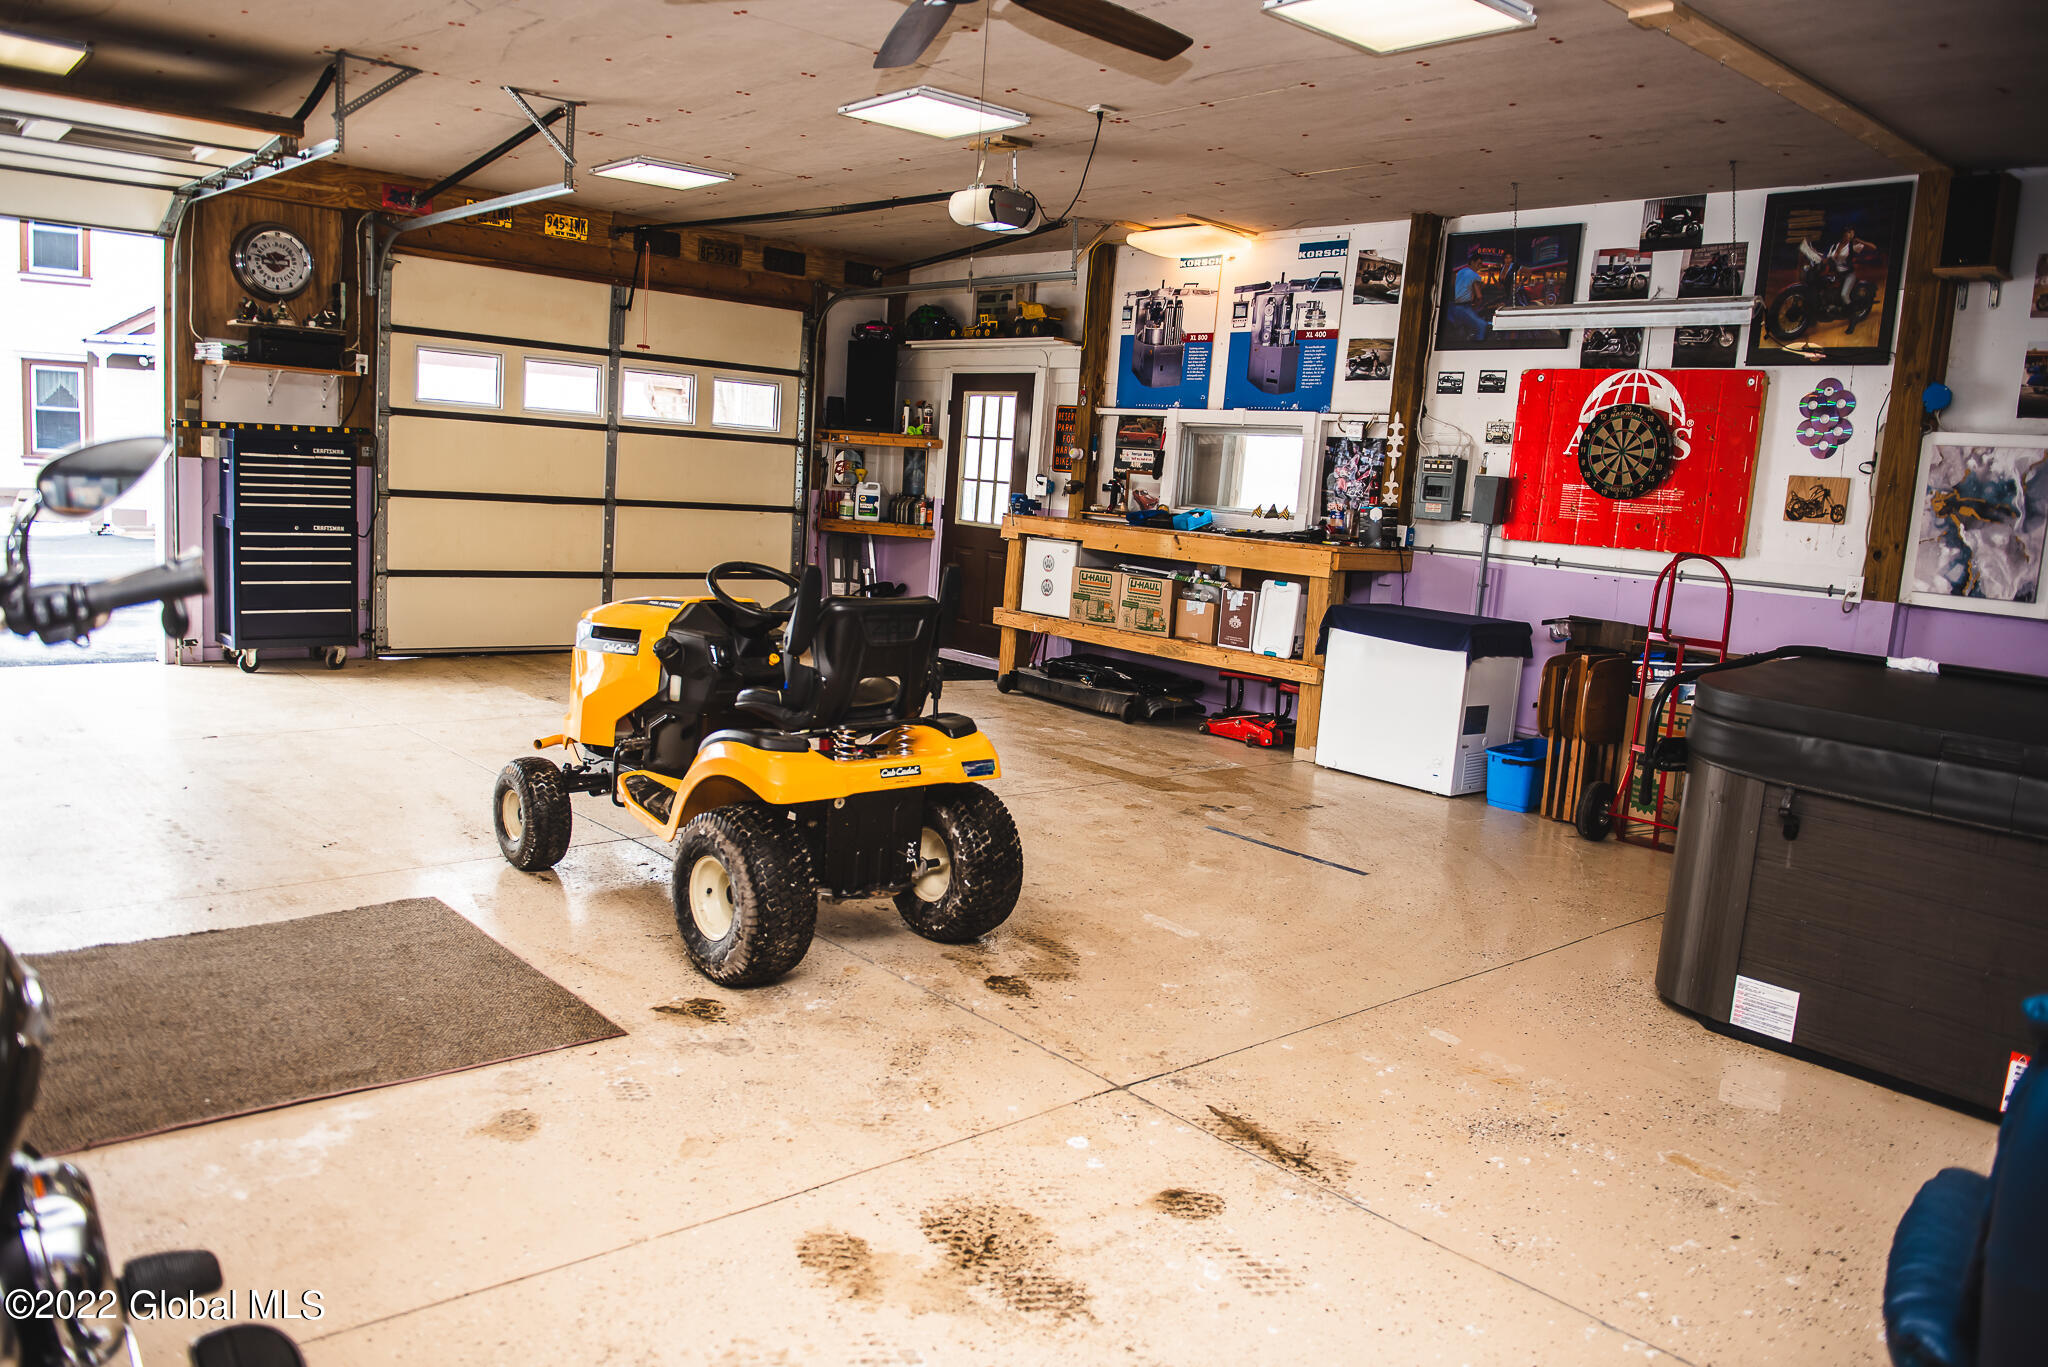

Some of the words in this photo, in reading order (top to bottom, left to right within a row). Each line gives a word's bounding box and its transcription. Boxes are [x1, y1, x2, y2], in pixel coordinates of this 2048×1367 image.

[1298, 248, 1348, 259] KORSCH
[1180, 257, 1222, 268] KORSCH
[1058, 412, 1076, 422] RESER
[1057, 423, 1076, 433] PARKI
[312, 447, 345, 455] CRAFTSMAN
[1081, 572, 1110, 584] U-HAUL
[1130, 579, 1160, 591] U-HAUL
[880, 768, 896, 778] Cub
[896, 766, 920, 776] Cadet
